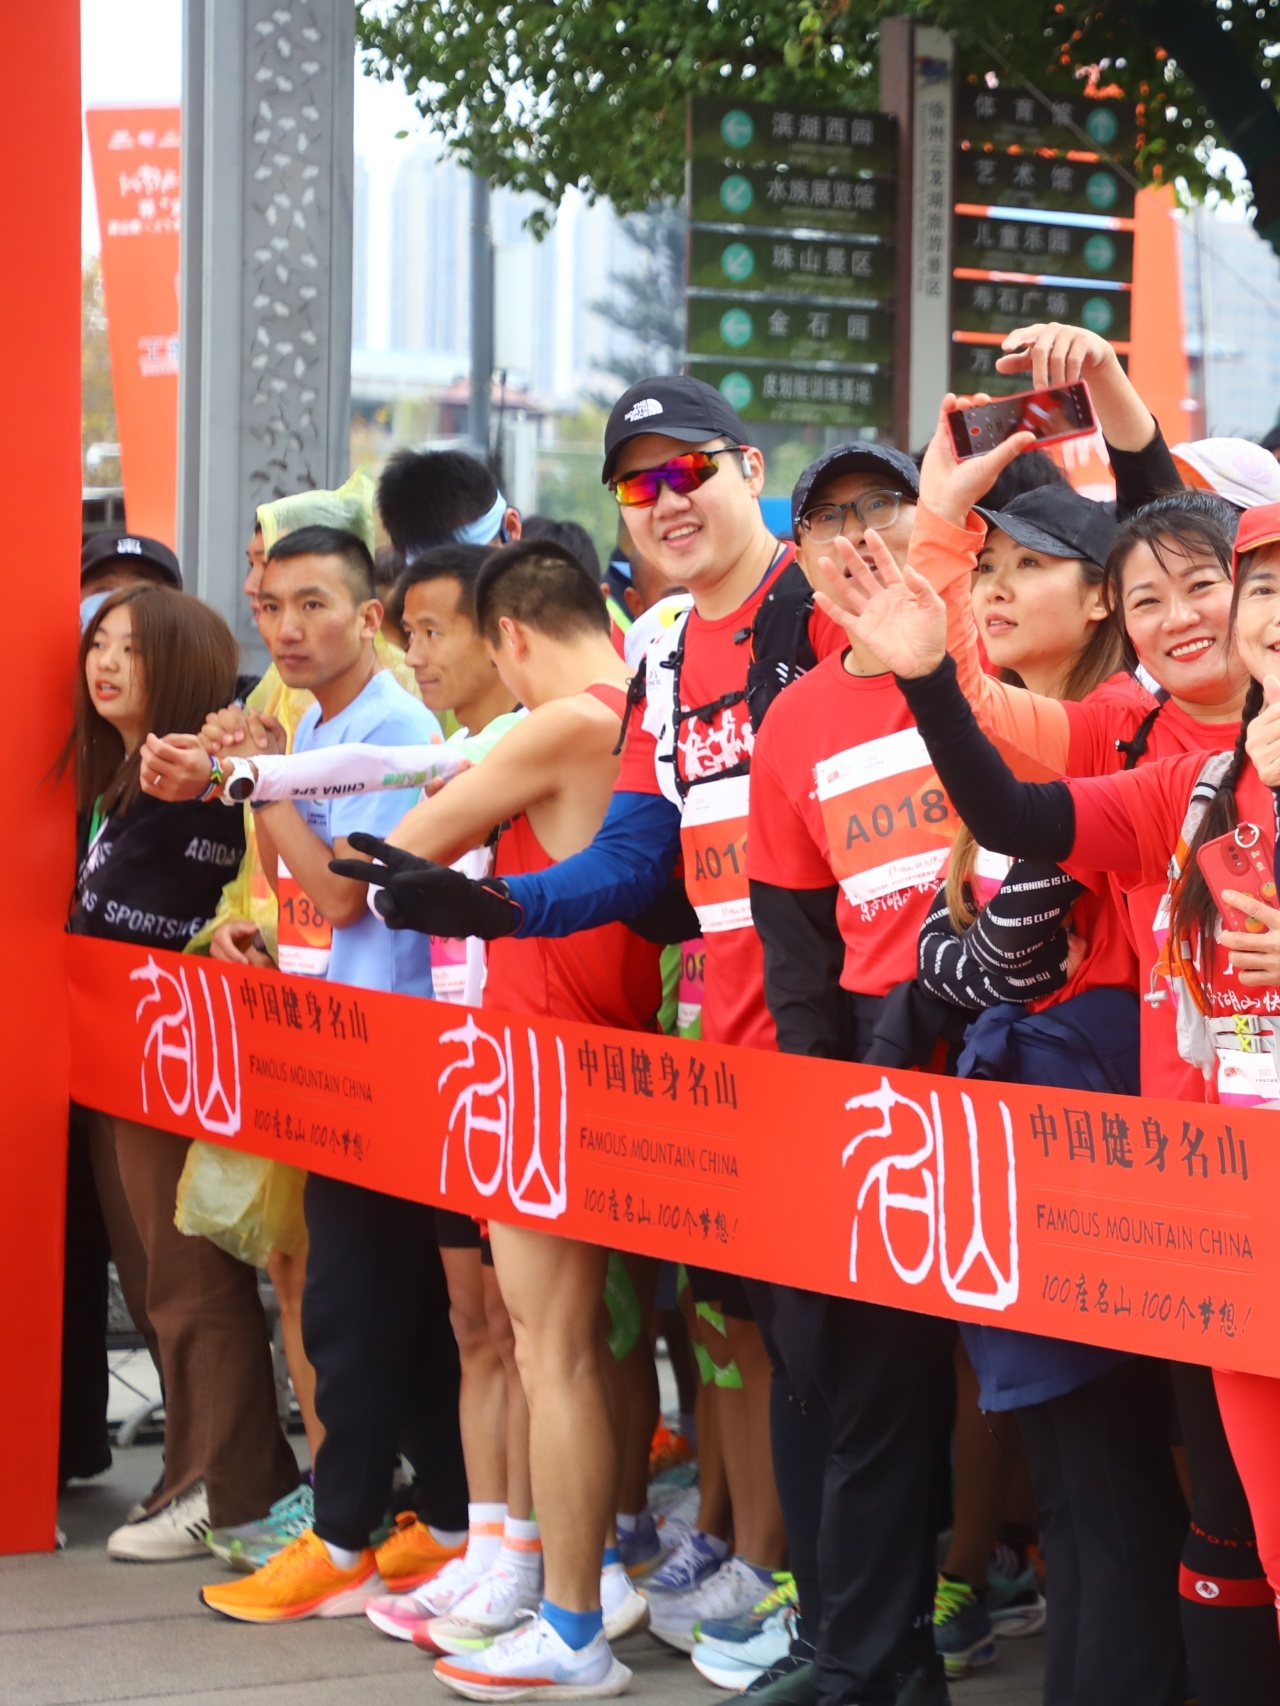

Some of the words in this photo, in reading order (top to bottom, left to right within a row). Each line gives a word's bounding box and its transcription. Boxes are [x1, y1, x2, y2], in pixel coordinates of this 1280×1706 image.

[771, 112, 874, 145] 滨湖西园
[974, 93, 1073, 126] 体育馆
[767, 175, 876, 209] 水族展览馆
[974, 159, 1073, 191] 艺术馆
[973, 222, 1071, 254] 儿童乐园
[772, 245, 873, 277] 珠山景区
[767, 308, 870, 341] 金石园
[846, 789, 961, 850] A018
[240, 979, 368, 1043] 中国健身名山
[250, 1055, 287, 1082] FAMOUS
[290, 1065, 339, 1094] MOUNTAIN
[342, 1076, 372, 1103] CHINA
[578, 1040, 737, 1110] 中国健身名山
[580, 1127, 627, 1157] FAMOUS
[630, 1138, 695, 1169] MOUNTAIN
[700, 1150, 739, 1178] CHINA
[1029, 1103, 1250, 1181] 中国健身名山
[1036, 1204, 1100, 1238] FAMOUS
[1106, 1216, 1193, 1250] MOUNTAIN
[1200, 1227, 1254, 1260] CHINA
